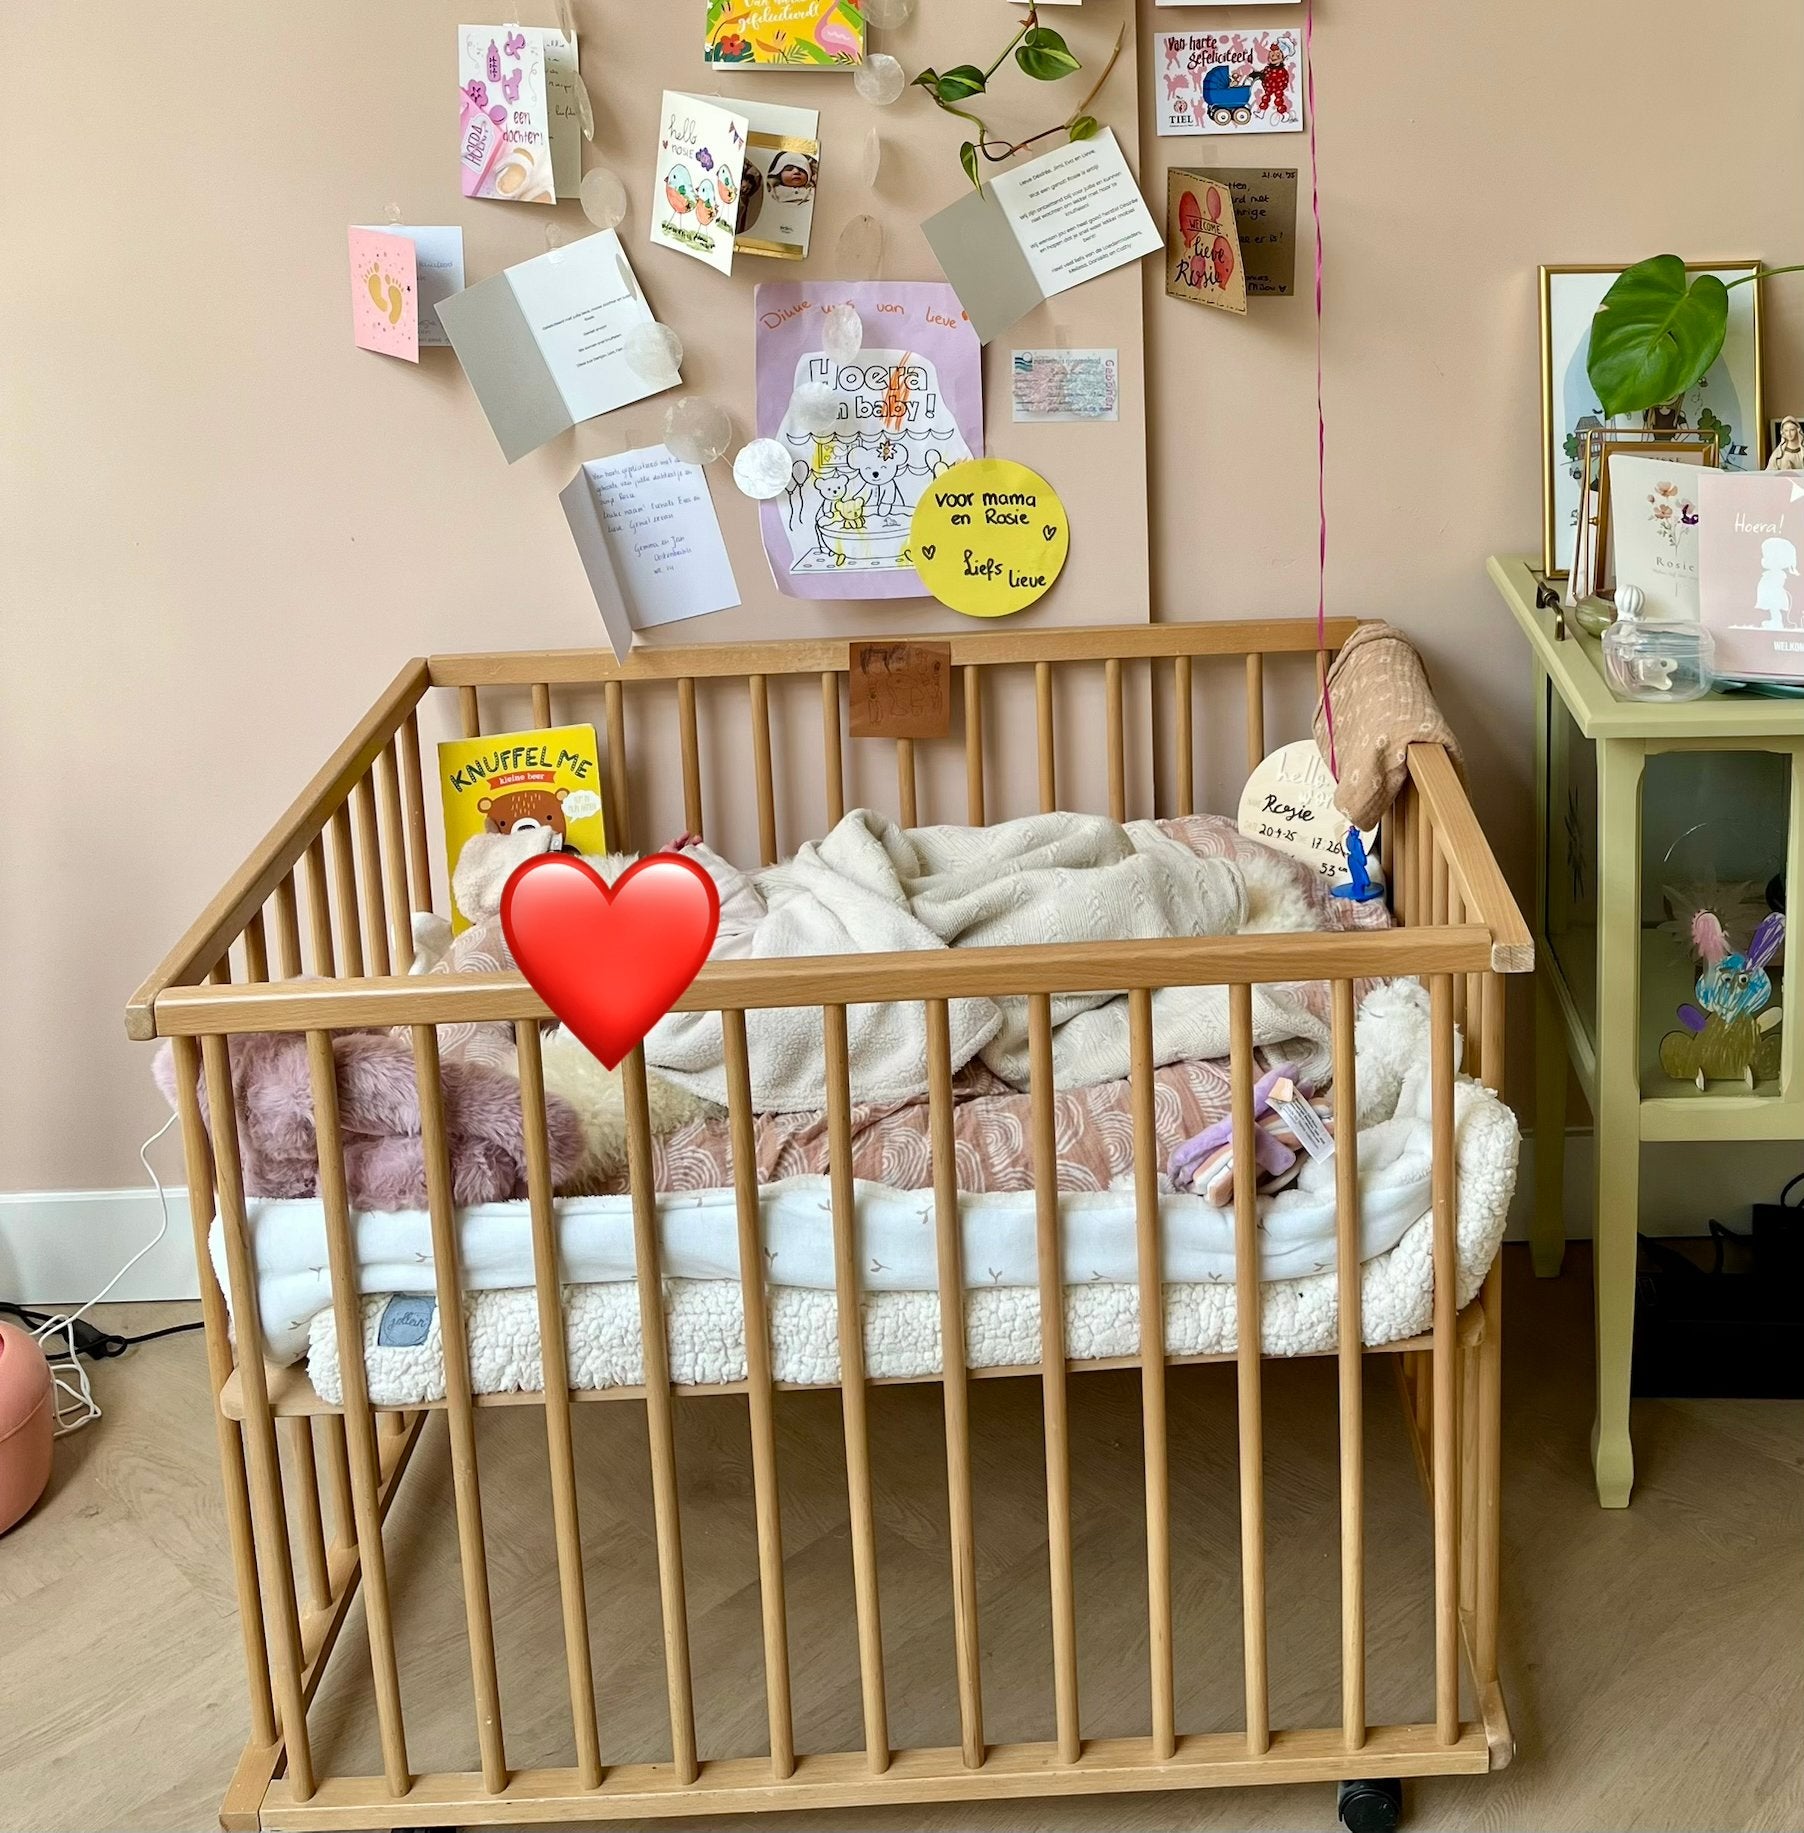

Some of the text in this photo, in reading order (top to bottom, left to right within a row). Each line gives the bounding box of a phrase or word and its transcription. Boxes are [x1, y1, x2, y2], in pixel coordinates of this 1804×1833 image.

[1168, 36, 1217, 51] Van harte
[1187, 48, 1253, 70] gefeliciteerd
[513, 111, 531, 125] een
[1169, 115, 1194, 124] TIEL
[935, 492, 1036, 508] voor mama
[951, 508, 1029, 525] en Rosie
[1734, 512, 1785, 534] Hoera!
[1656, 556, 1695, 571] Rosie
[450, 746, 593, 793] KNUFFEL ME
[499, 772, 545, 785] kleine beer
[1319, 862, 1336, 877] 53
